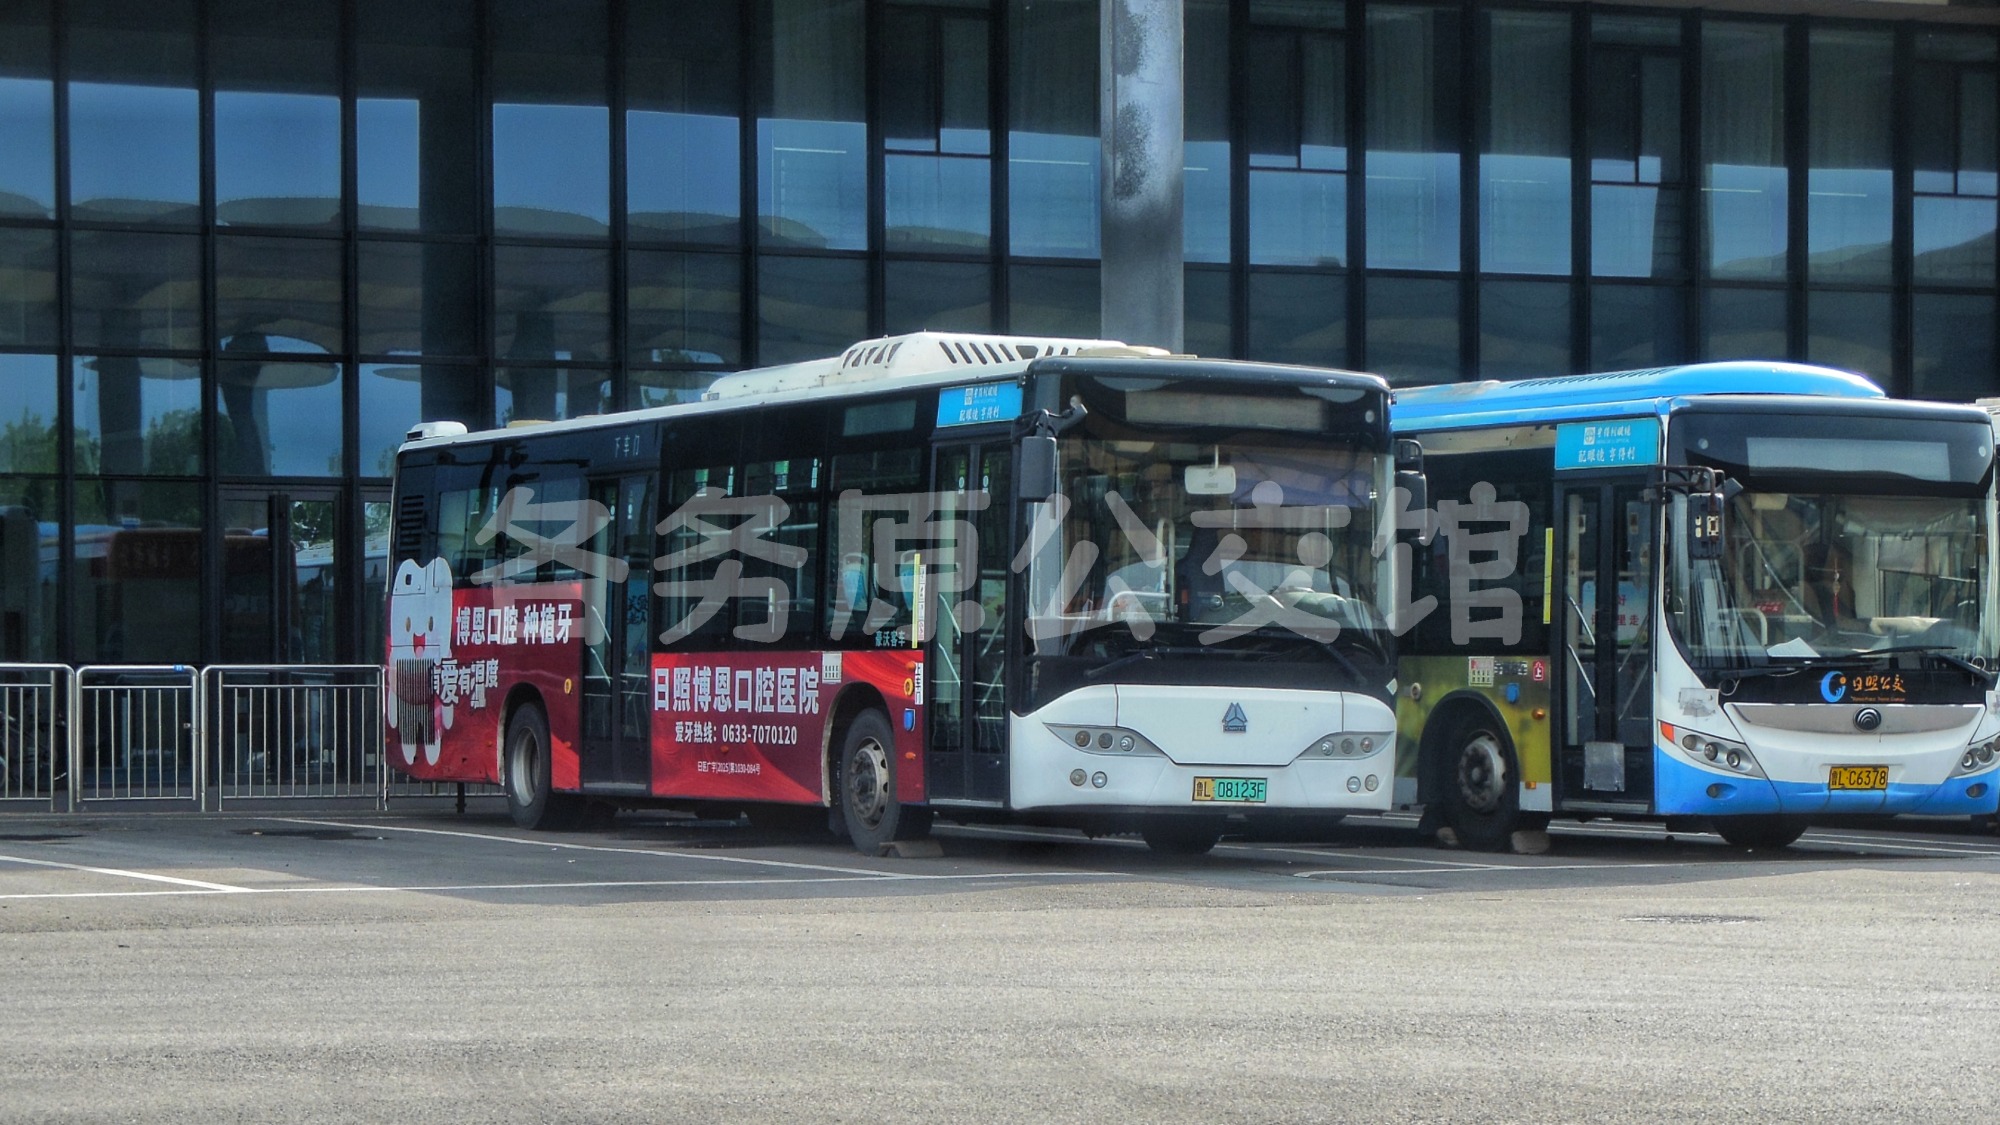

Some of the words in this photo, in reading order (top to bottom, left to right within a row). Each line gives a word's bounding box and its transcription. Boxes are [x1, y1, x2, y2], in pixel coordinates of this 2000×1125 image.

[456, 605, 518, 646] 博恩口腔
[523, 603, 573, 645] 种植牙
[654, 666, 820, 715] 日照博恩口腔医院
[1852, 674, 1906, 693] 日照公交
